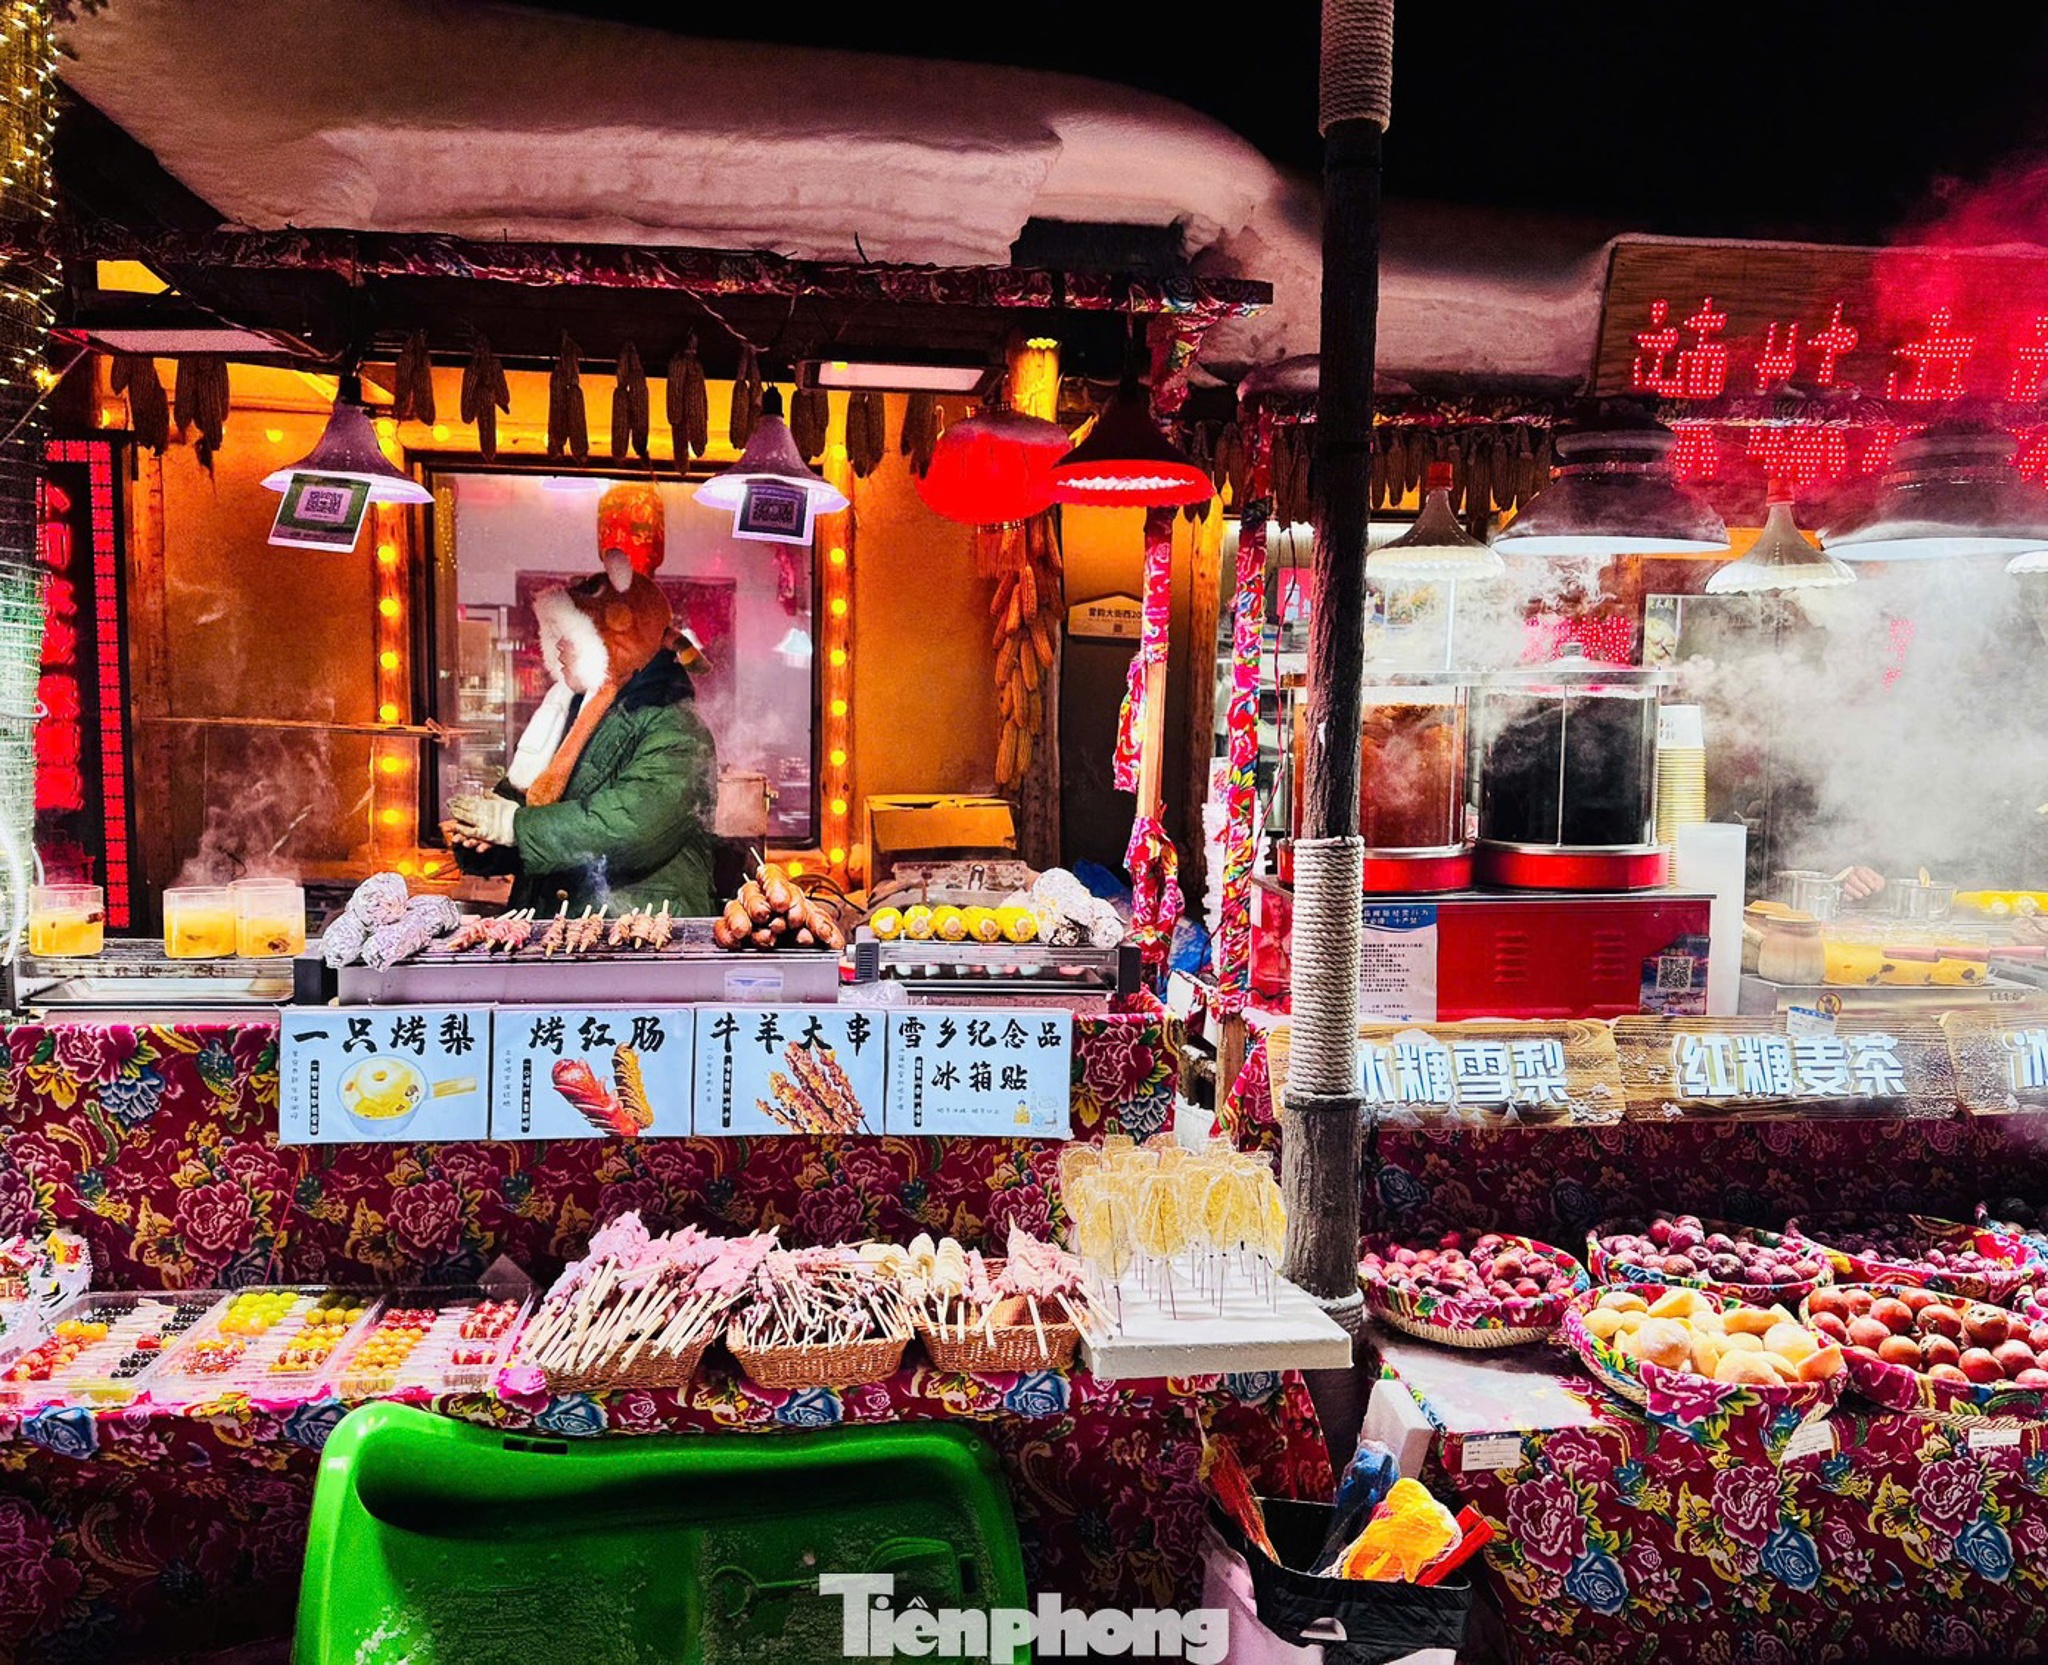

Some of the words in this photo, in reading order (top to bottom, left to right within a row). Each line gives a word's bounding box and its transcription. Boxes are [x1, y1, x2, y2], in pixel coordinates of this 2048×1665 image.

[291, 1013, 476, 1055] 一只烤梨
[528, 1015, 666, 1055] 烤红肠
[709, 1012, 872, 1056] 牛羊大串
[898, 1015, 1062, 1050] 雪乡纪念品
[930, 1062, 1029, 1093] 冰箱贴
